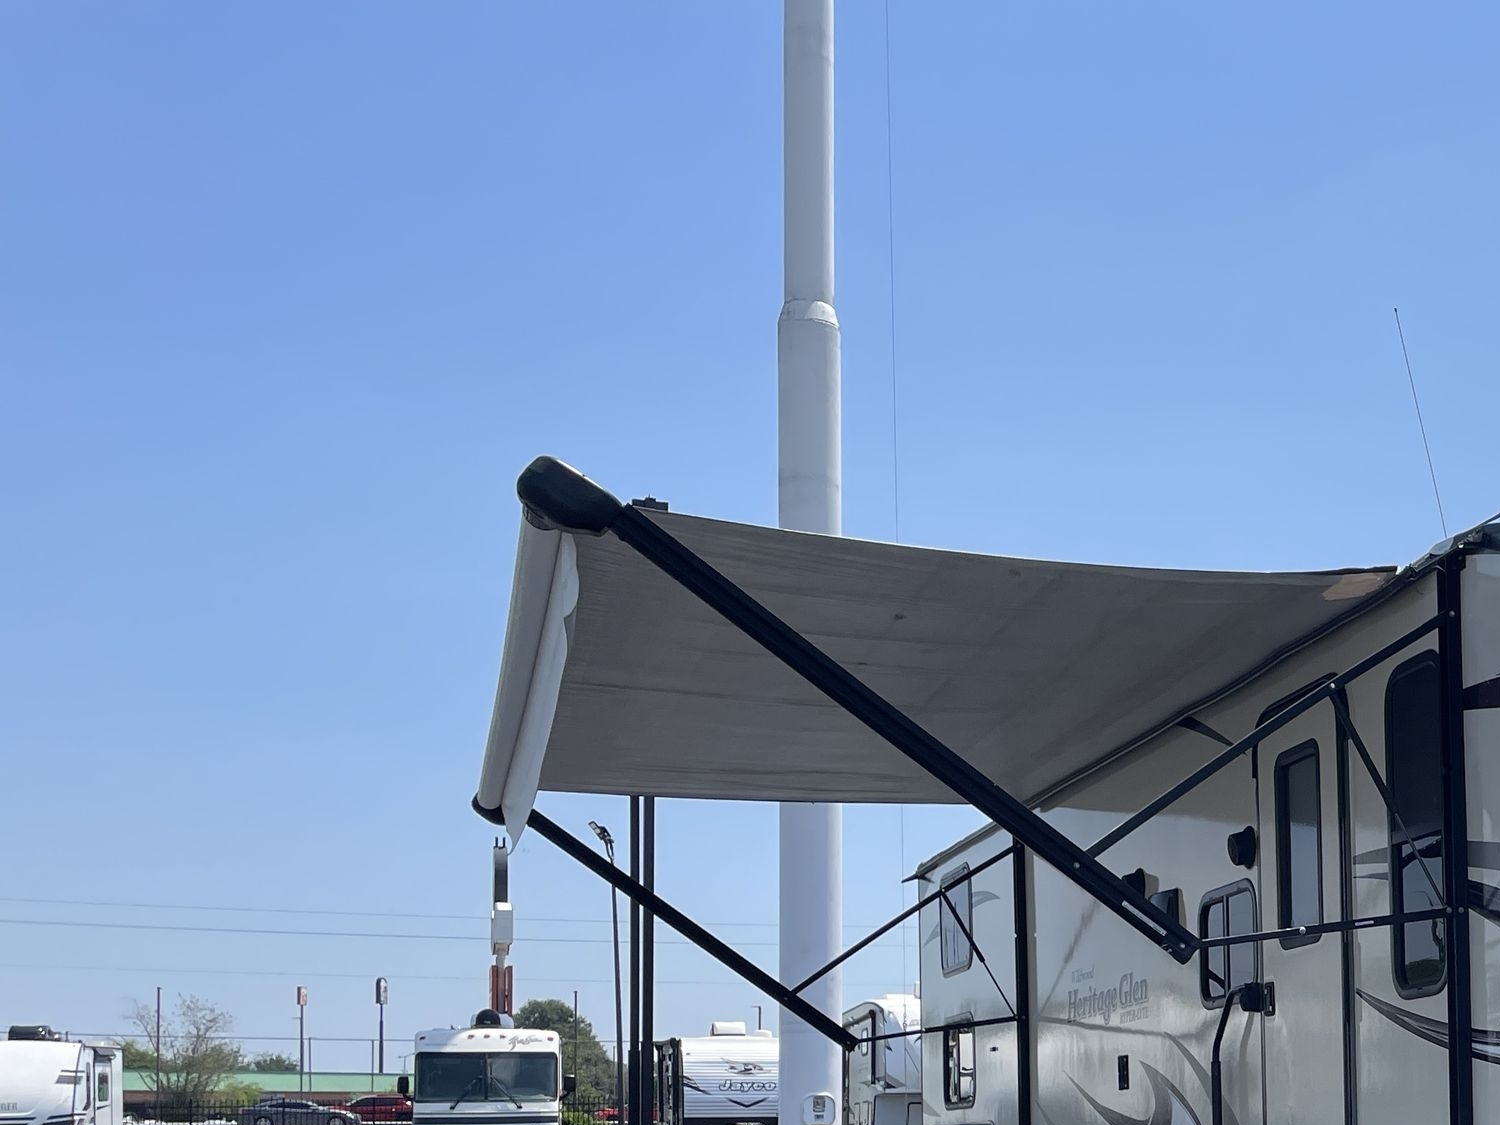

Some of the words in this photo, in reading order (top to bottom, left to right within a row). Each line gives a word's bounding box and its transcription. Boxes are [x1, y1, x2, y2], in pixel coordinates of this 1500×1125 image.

[1068, 986, 1118, 1025] Heritage
[1119, 972, 1149, 1007] Glen
[719, 1080, 776, 1092] Jayco
